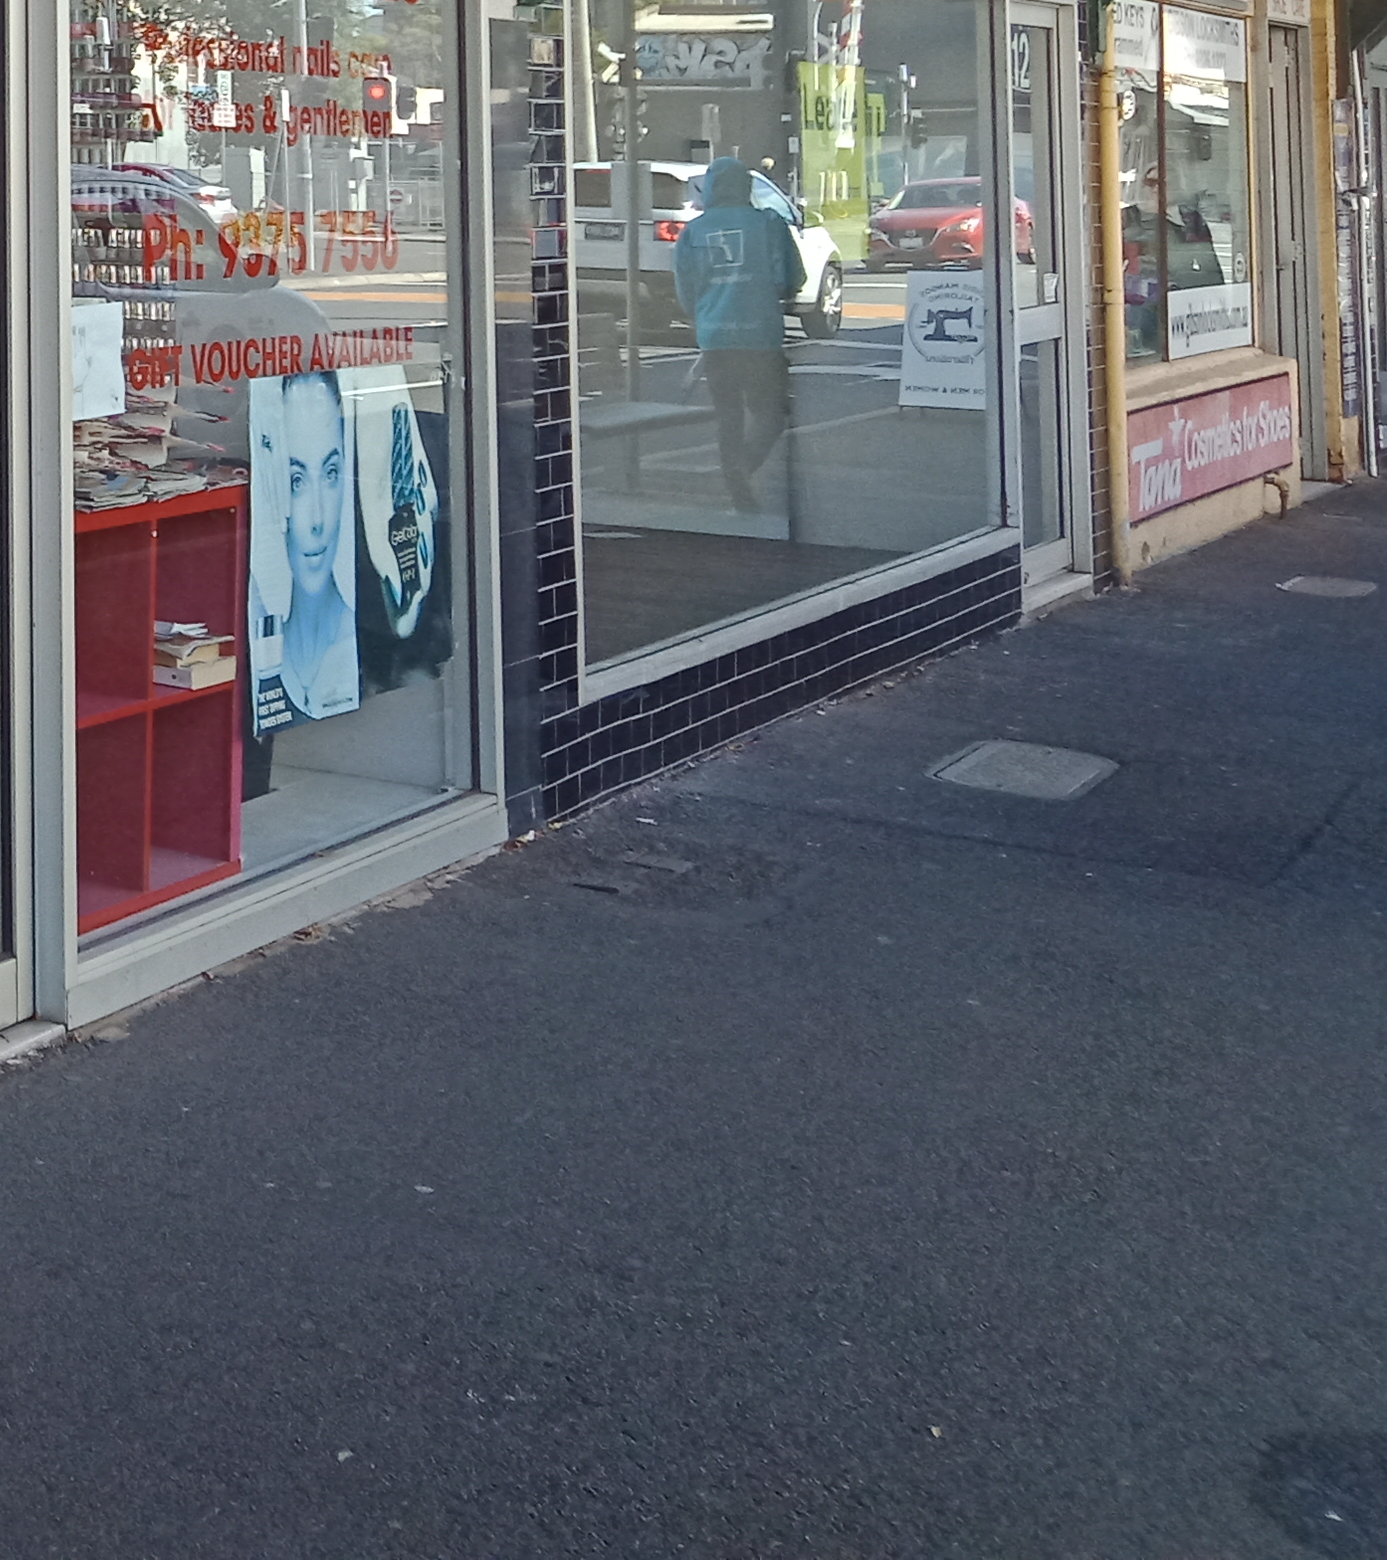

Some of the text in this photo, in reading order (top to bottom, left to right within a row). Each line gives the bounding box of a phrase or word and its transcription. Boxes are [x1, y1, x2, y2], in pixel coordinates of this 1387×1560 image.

[1011, 32, 1030, 88] 12
[262, 94, 278, 135] &
[802, 81, 858, 132] Leae
[130, 326, 414, 391] GIFT VOUCHER AVAILABLE
[1184, 413, 1242, 471] Cosmetics
[1259, 399, 1291, 448] Shoes
[1131, 436, 1183, 513] Tana
